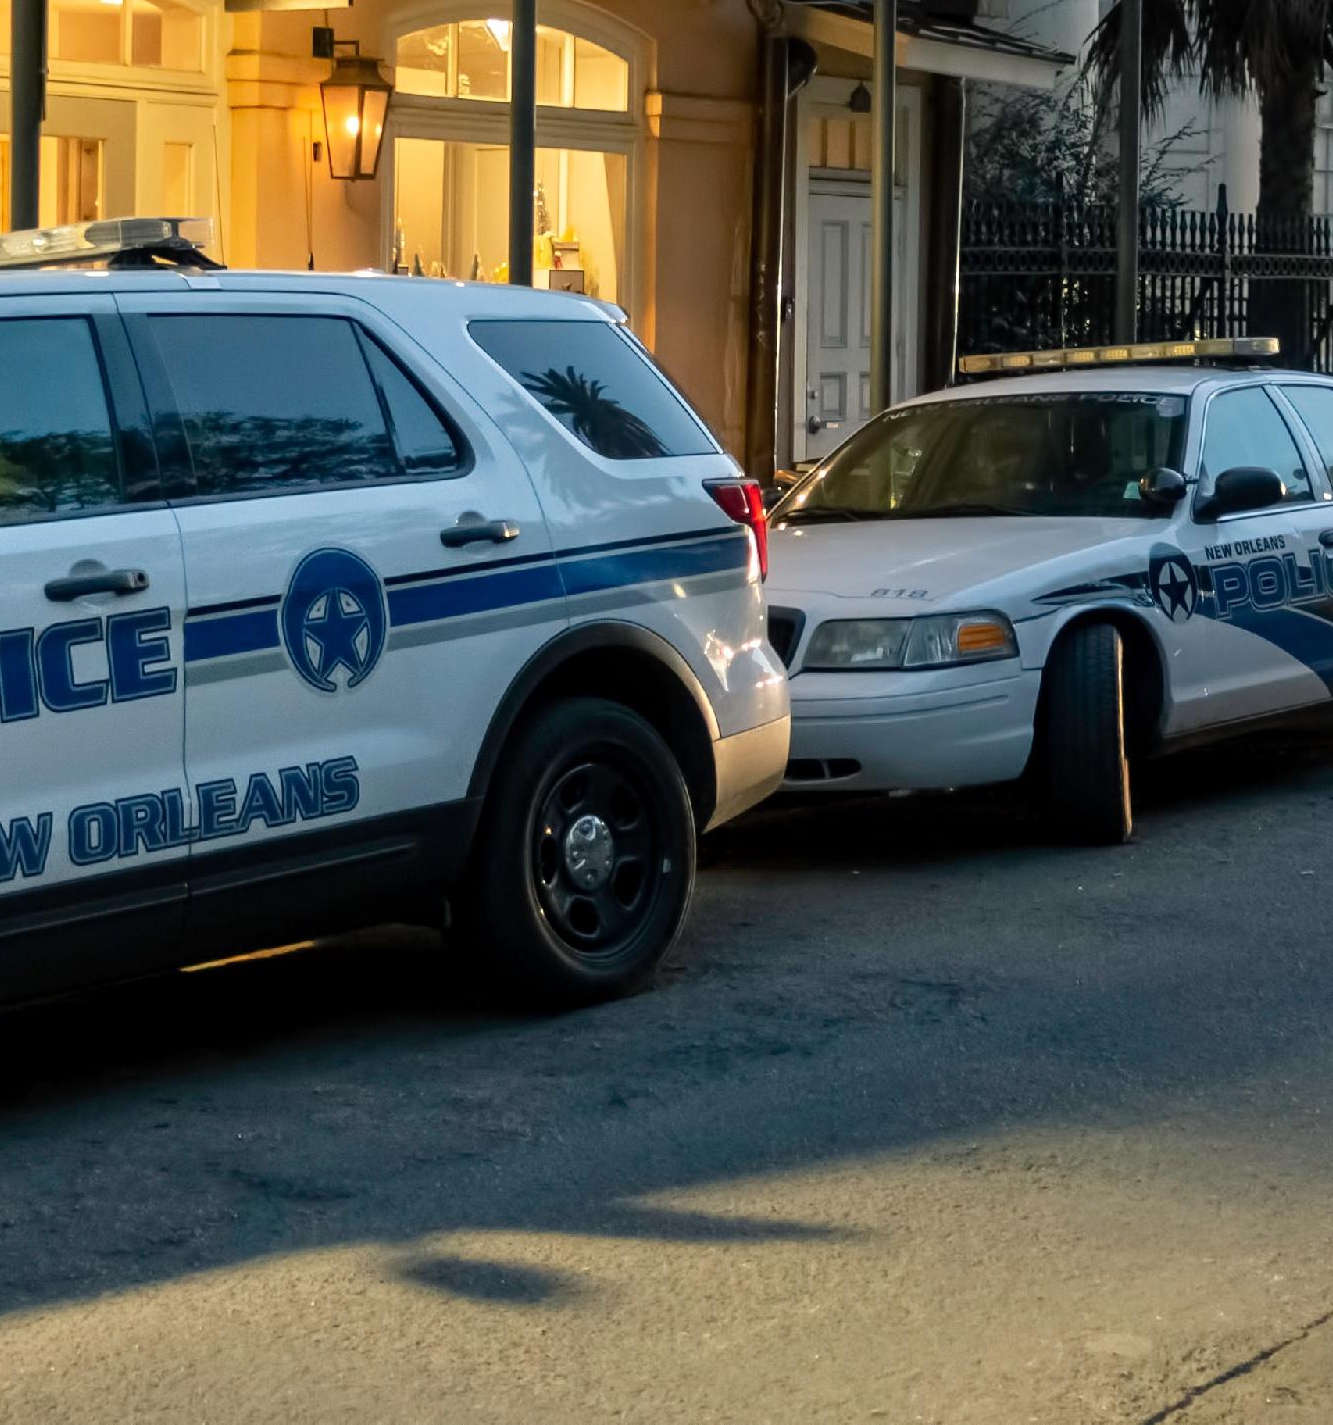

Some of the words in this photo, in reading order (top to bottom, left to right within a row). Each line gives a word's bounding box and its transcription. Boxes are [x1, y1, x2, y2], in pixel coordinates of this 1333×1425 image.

[1204, 543, 1235, 560] NEW
[1236, 534, 1286, 556] ORLEANS
[67, 754, 361, 867] ORLEANS
